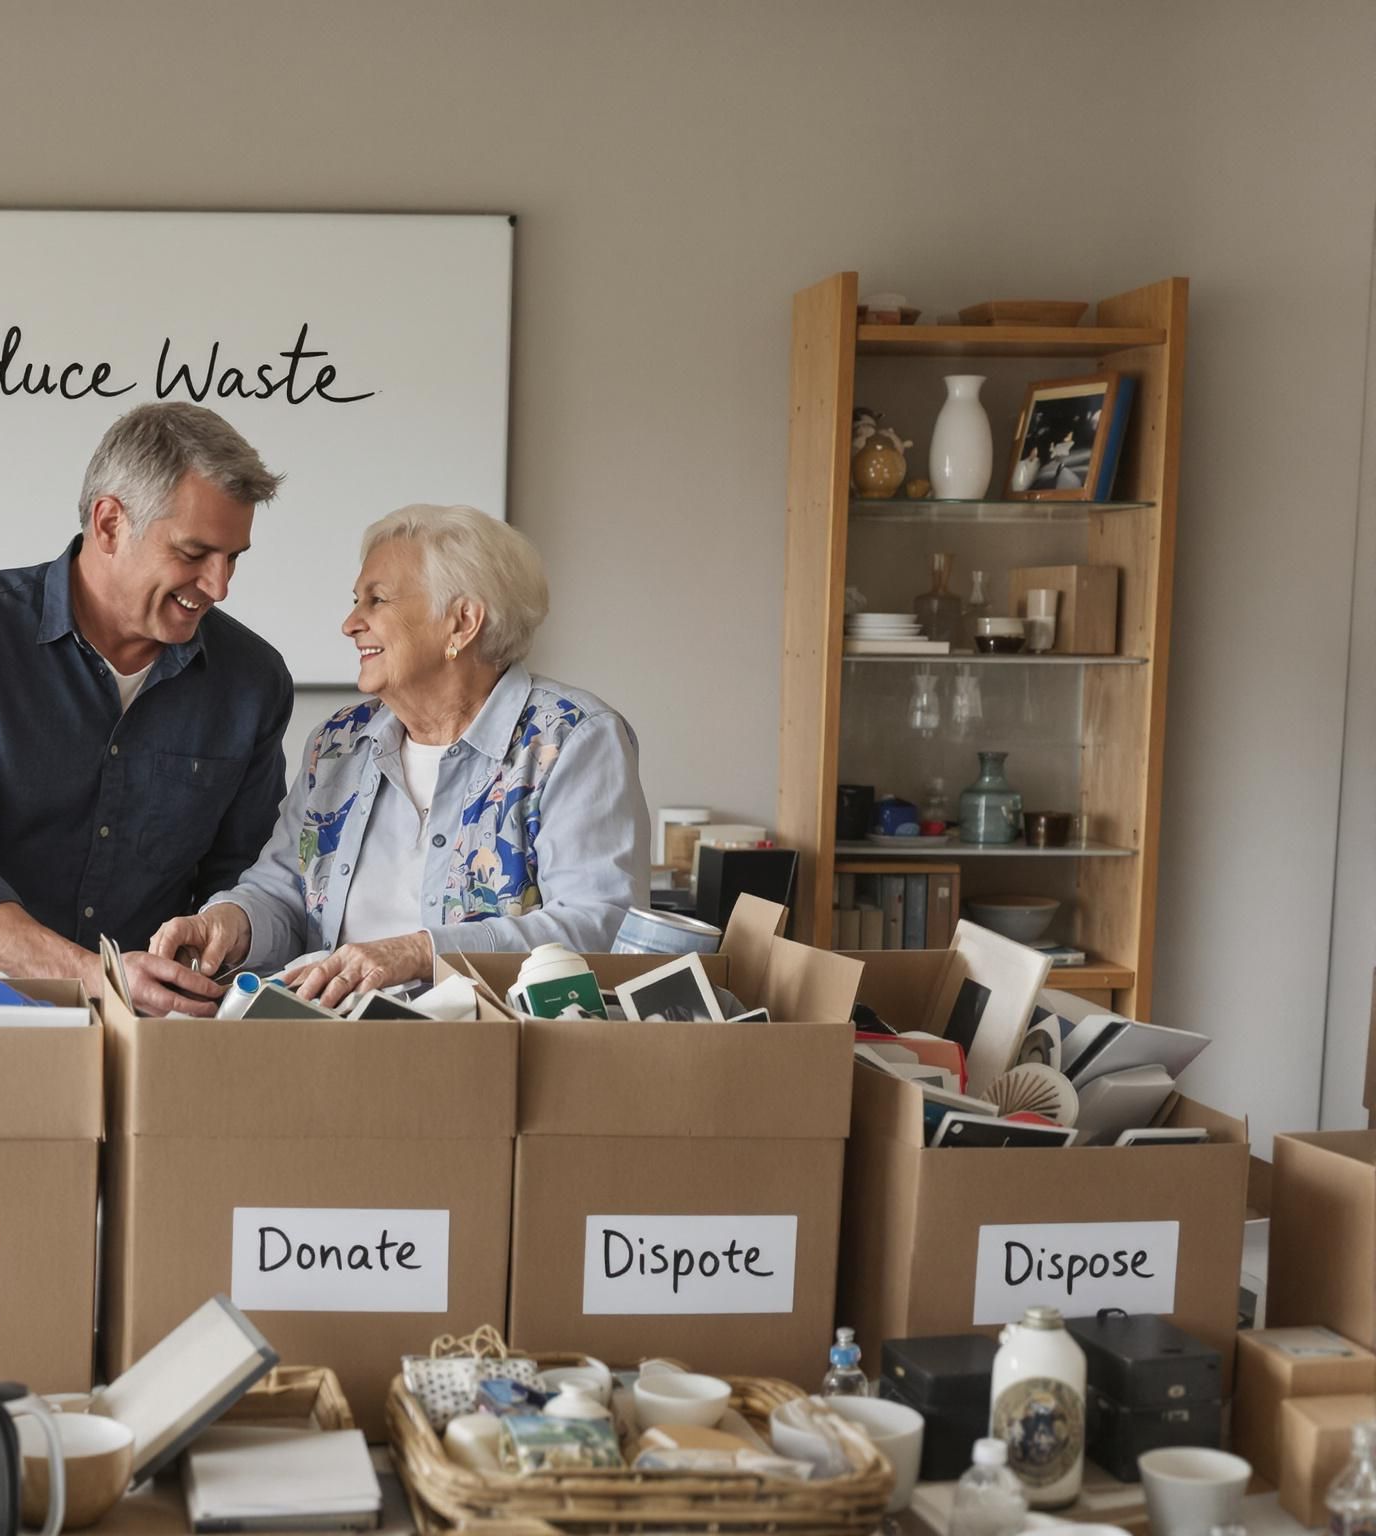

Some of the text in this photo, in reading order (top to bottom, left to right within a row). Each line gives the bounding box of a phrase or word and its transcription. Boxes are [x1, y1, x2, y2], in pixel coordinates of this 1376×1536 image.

[155, 322, 375, 405] Waste
[258, 1226, 423, 1272] Donate
[602, 1229, 774, 1294] Dispote
[1004, 1240, 1155, 1296] Dispose
